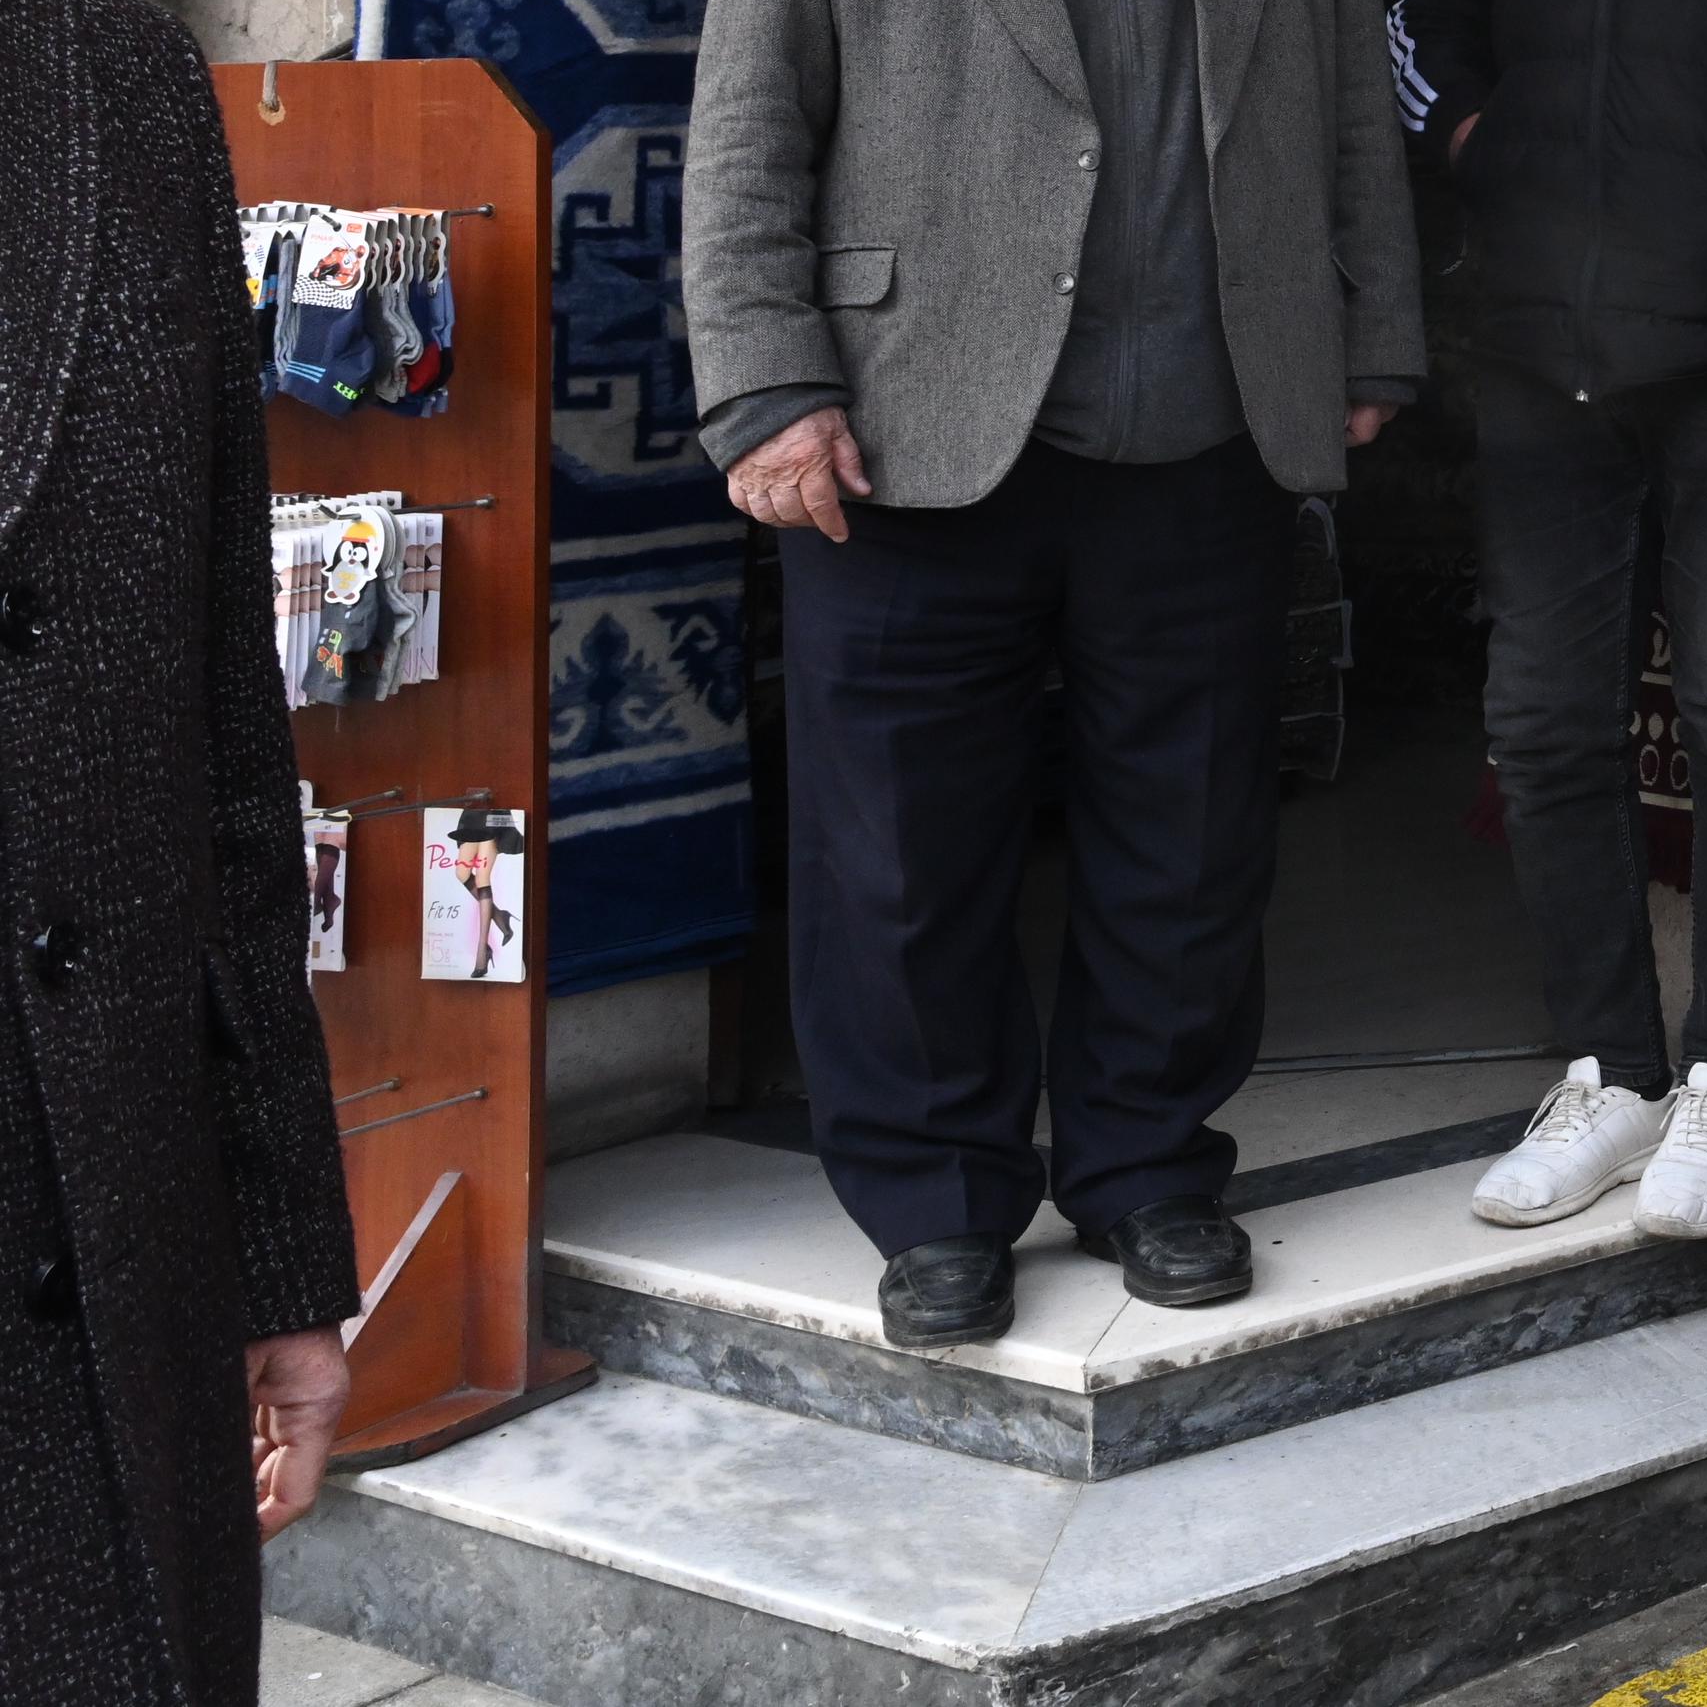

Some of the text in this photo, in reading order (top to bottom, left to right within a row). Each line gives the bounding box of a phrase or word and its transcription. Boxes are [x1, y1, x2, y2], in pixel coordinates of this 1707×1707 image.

[426, 844, 488, 870] Penti
[428, 901, 461, 920] Fit 15
